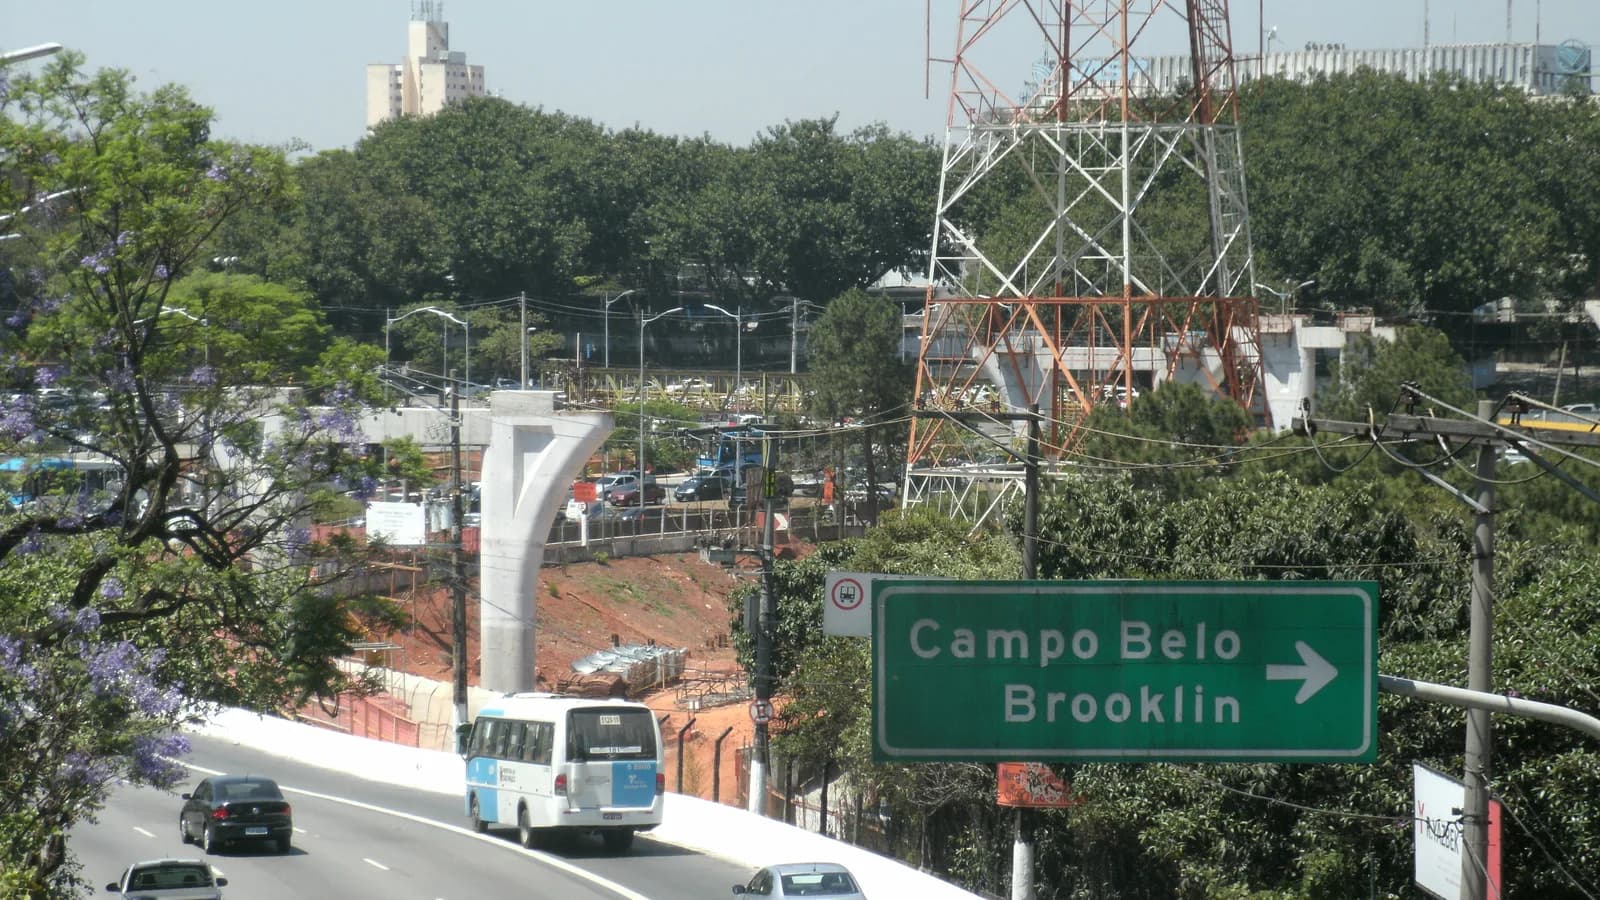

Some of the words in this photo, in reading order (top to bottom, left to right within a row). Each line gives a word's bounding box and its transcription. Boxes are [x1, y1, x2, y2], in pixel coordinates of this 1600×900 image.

[909, 618, 1099, 668] Campo
[1119, 620, 1242, 660] Belo
[1004, 684, 1241, 723] Brooklin
